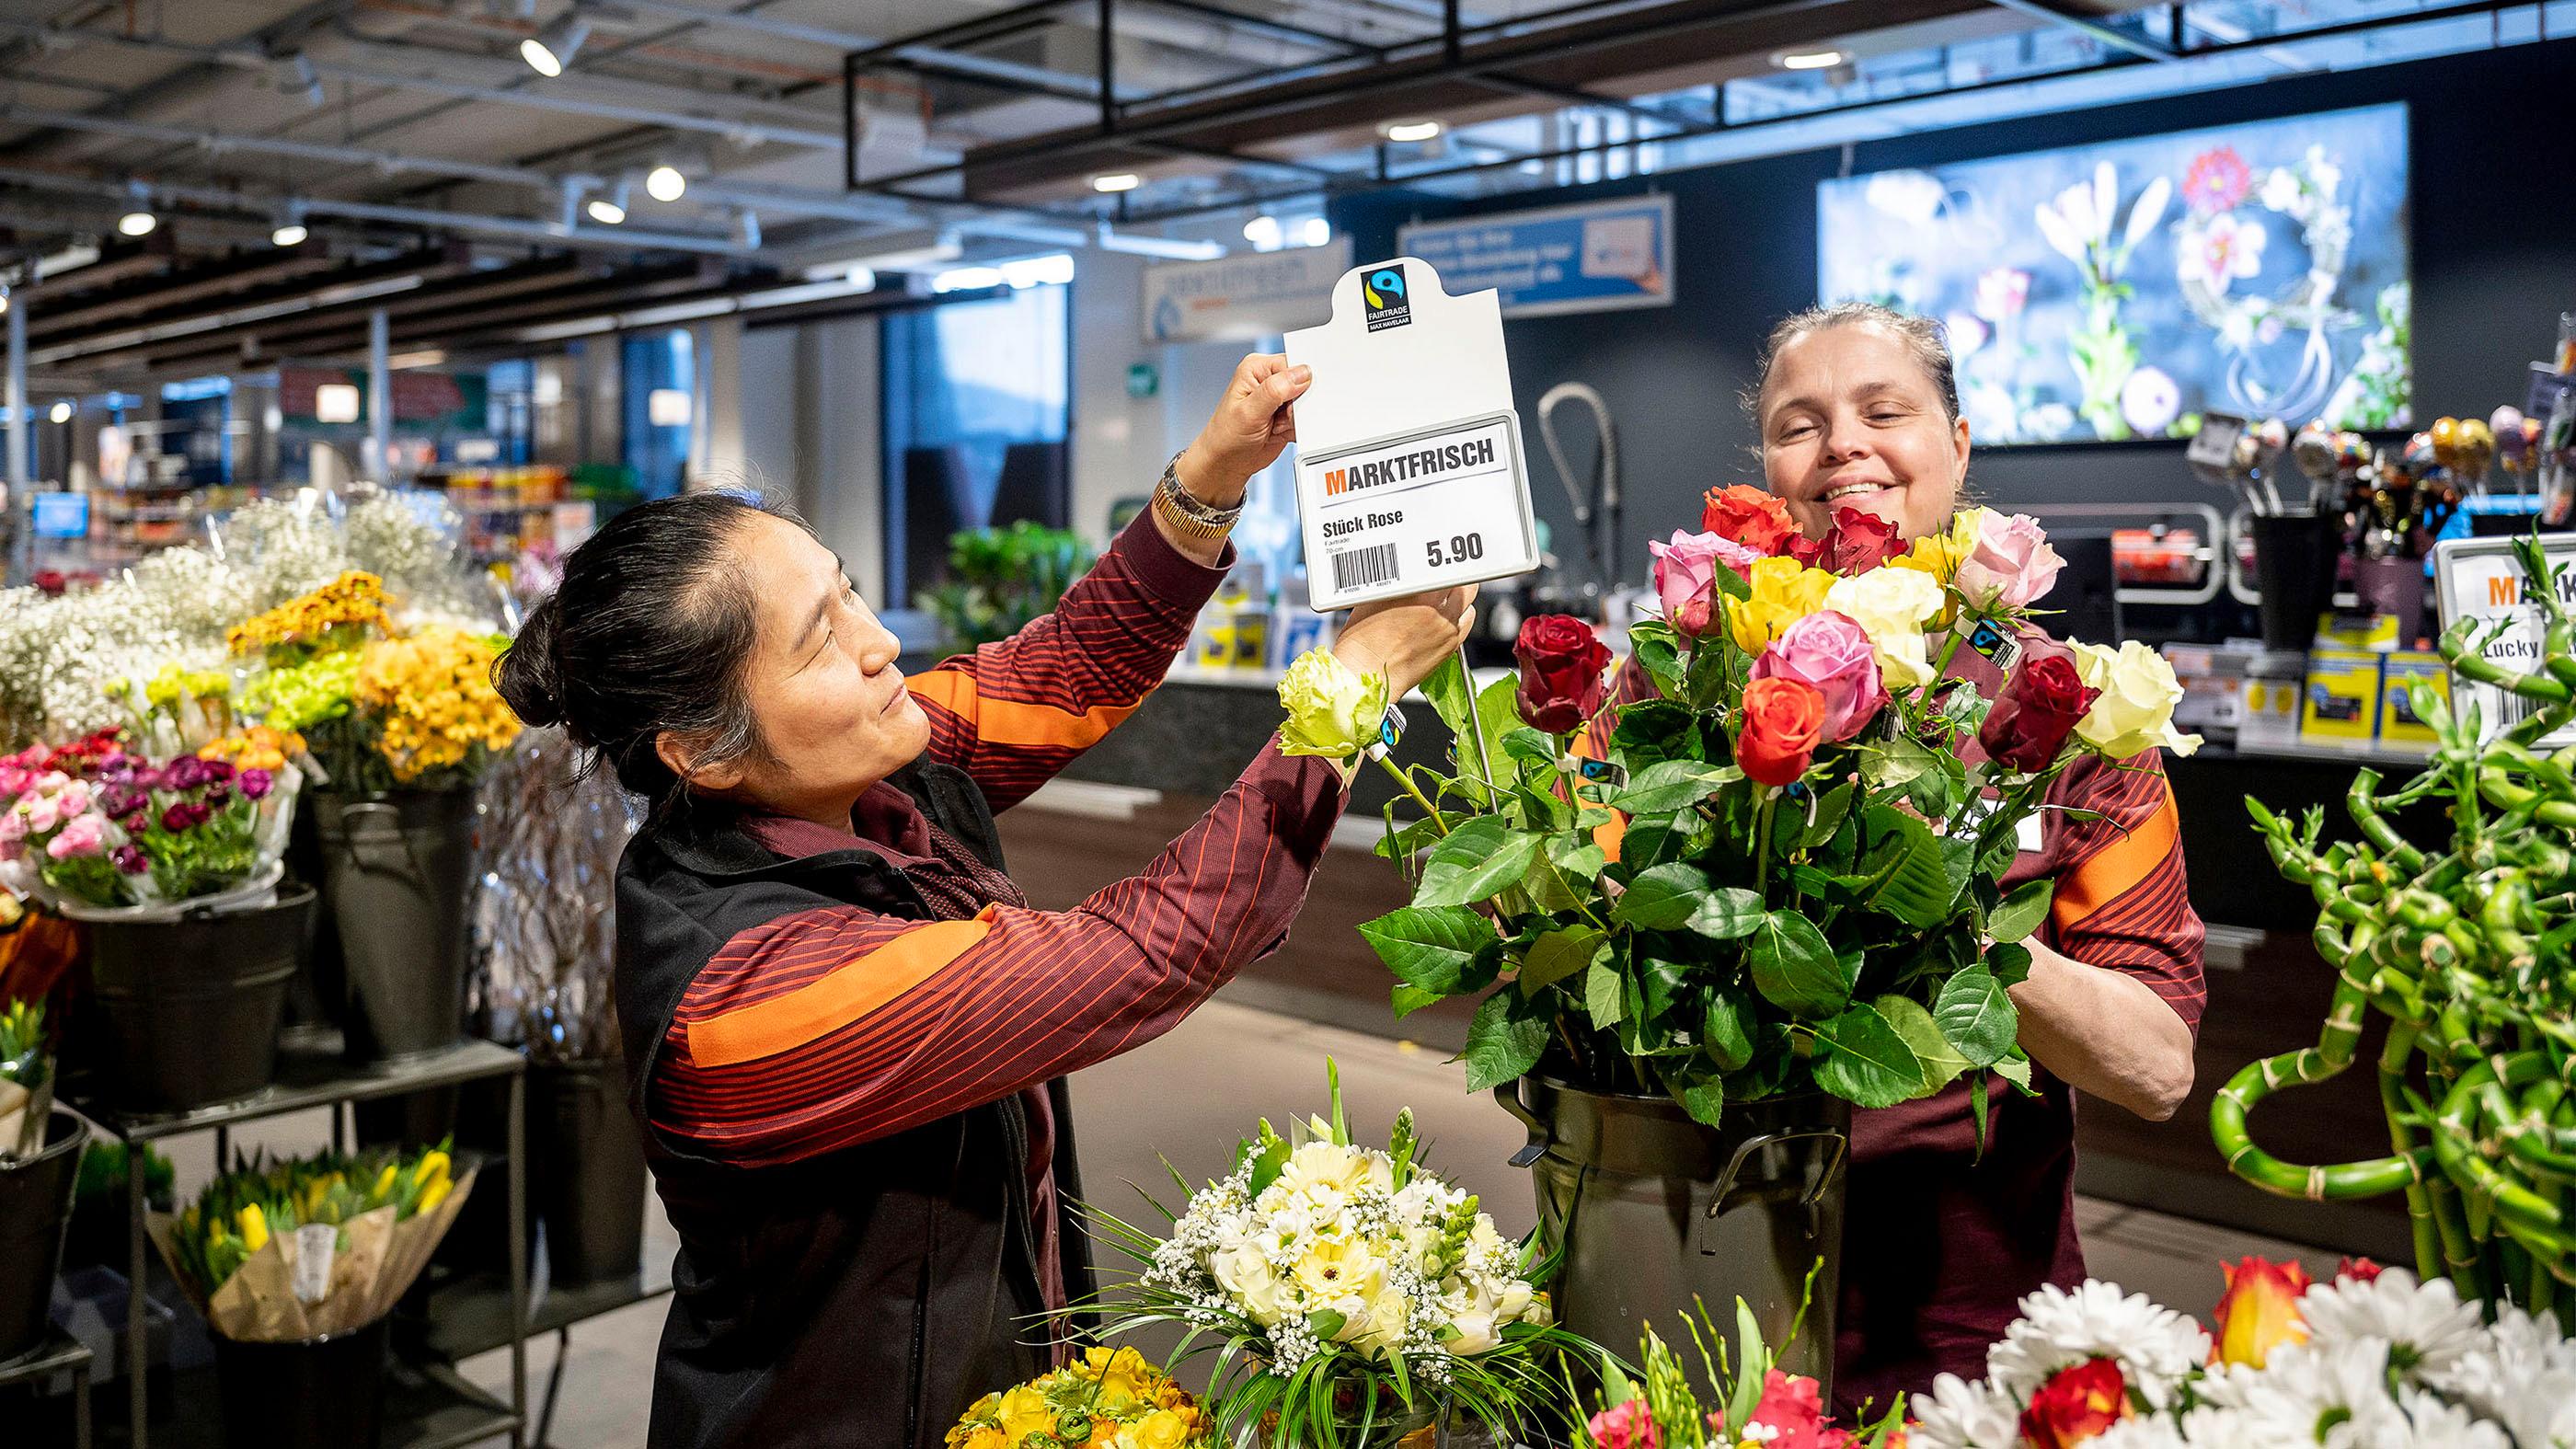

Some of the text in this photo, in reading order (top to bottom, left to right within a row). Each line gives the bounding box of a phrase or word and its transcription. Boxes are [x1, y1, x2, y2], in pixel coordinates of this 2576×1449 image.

[1368, 305, 1408, 320] FAIRTRADE
[1383, 317, 1409, 328] HAVELAAR
[1325, 438, 1494, 496] MARKTFRISCH
[1323, 511, 1403, 537] Stück Rose
[1426, 533, 1483, 568] 5.90
[2489, 574, 2576, 606] MAK
